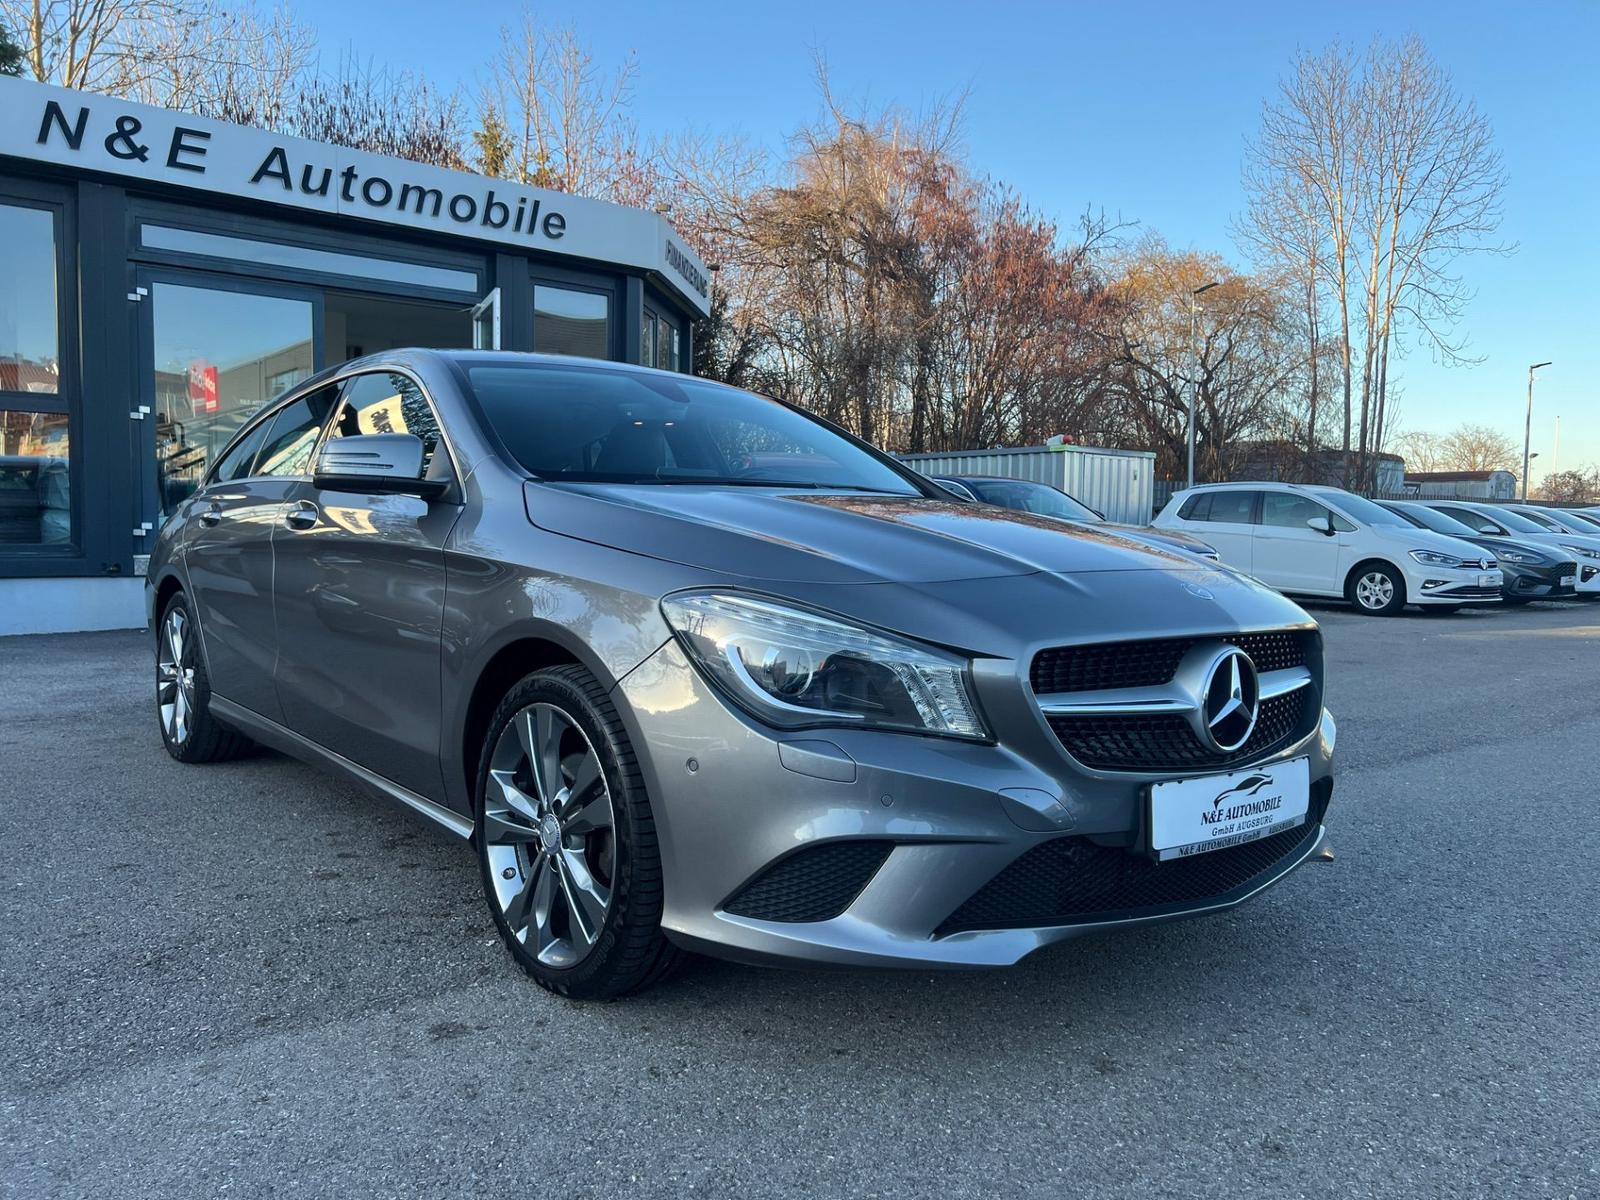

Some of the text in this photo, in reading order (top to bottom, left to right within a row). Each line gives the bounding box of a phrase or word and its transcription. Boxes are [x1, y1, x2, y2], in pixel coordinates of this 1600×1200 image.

[249, 146, 567, 240] Automobile
[1201, 796, 1282, 826] N&E AUTOMOBILE
[1211, 814, 1273, 837] GmbH AUGSBURG
